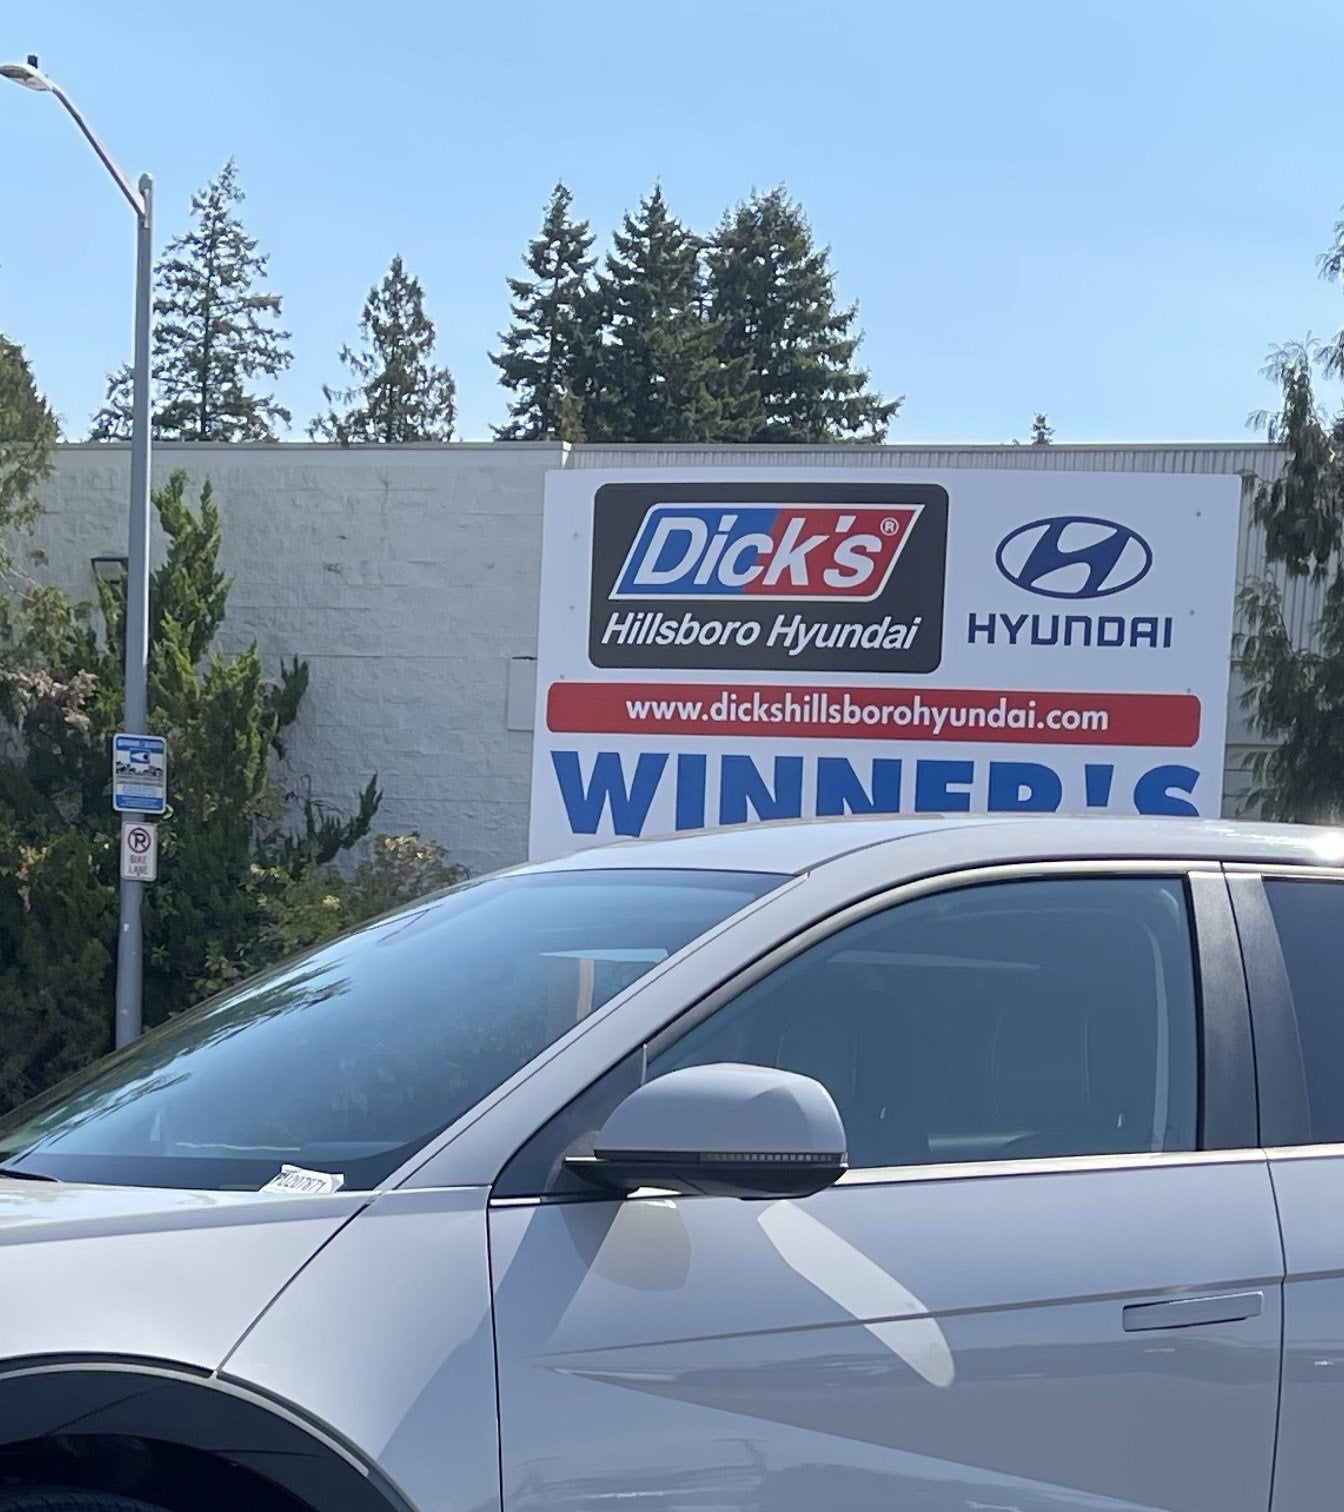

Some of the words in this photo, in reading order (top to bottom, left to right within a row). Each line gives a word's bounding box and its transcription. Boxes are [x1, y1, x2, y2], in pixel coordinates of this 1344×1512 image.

[601, 611, 762, 647] Hillsboro
[765, 614, 923, 656] Hyundai
[967, 612, 1174, 649] HYUNDAI
[624, 692, 1110, 737] www.dickshillsborohyundai.com
